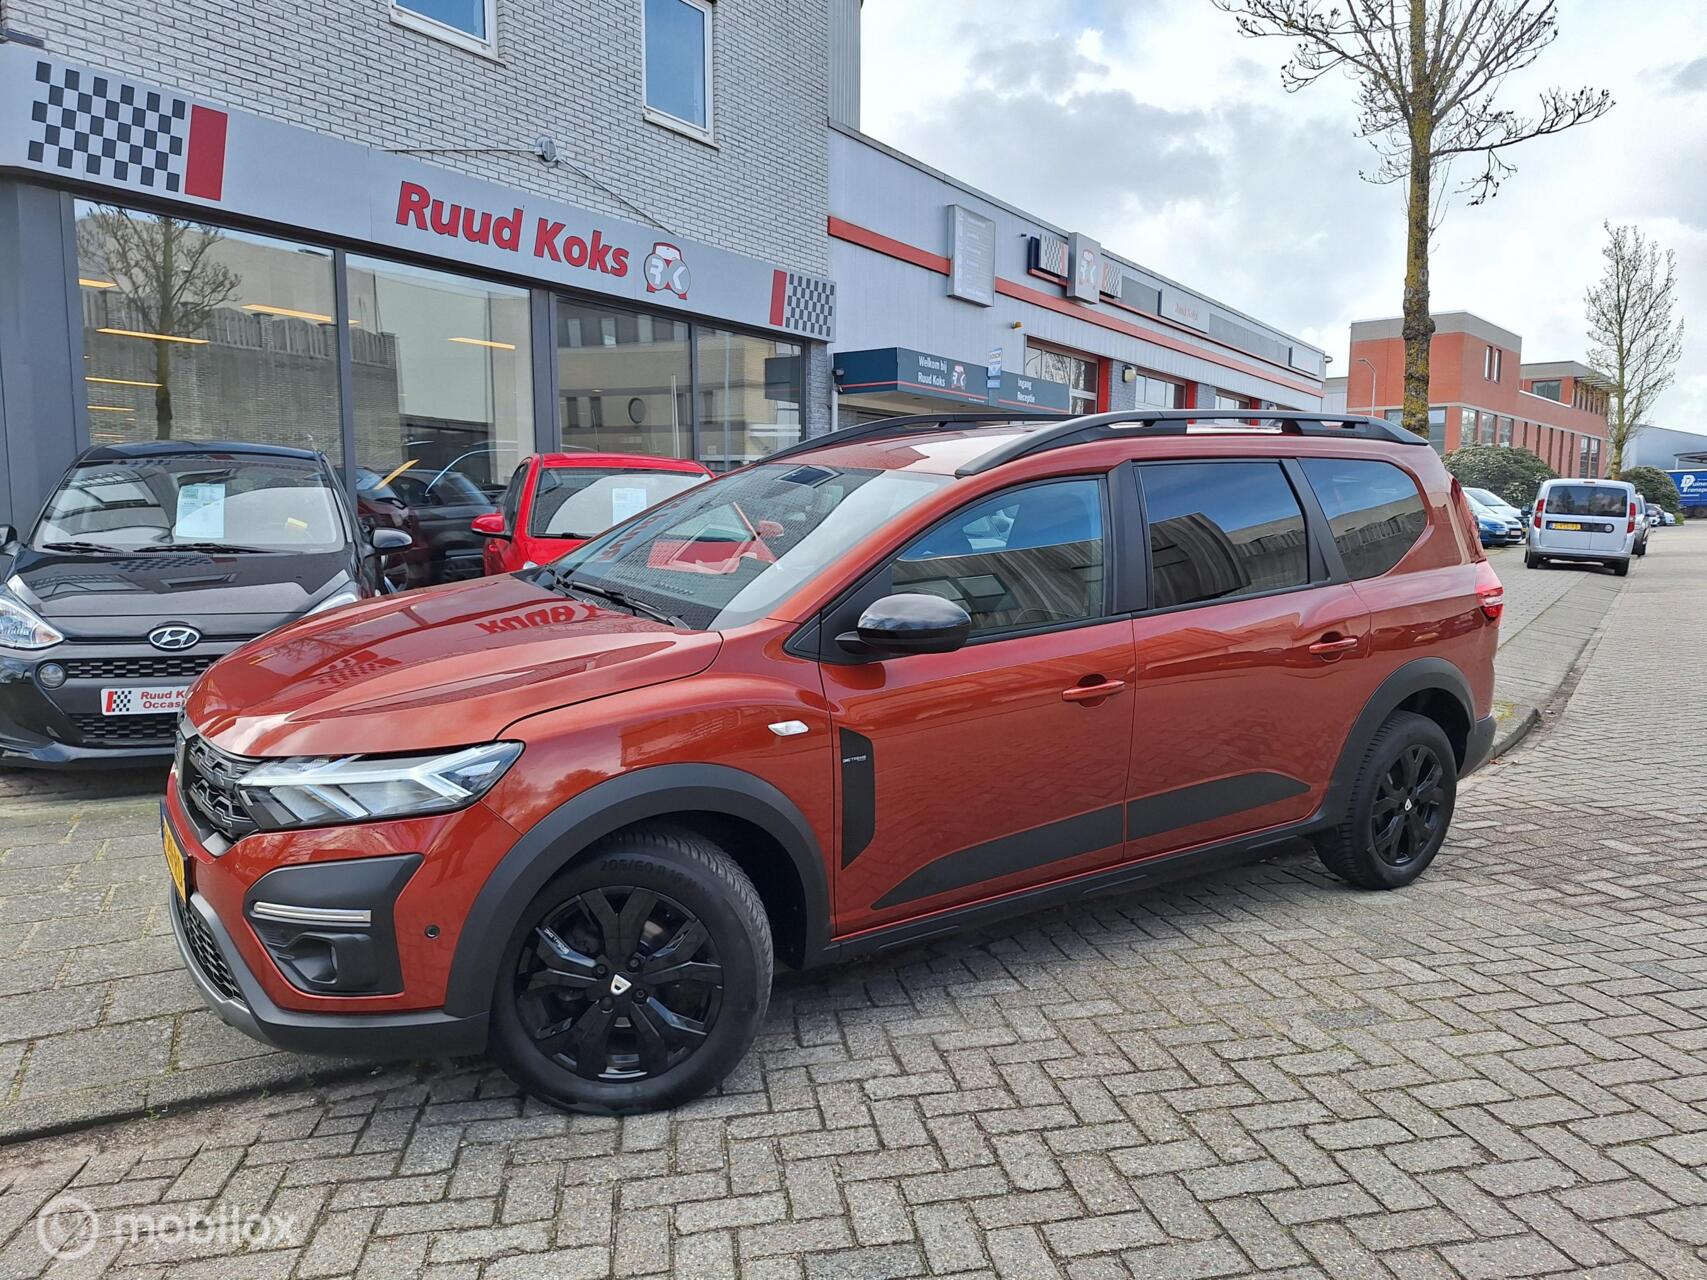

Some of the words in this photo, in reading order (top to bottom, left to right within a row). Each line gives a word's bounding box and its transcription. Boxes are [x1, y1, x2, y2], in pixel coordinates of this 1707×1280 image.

[396, 180, 524, 252] Ruud
[533, 217, 629, 277] Koks
[918, 355, 940, 370] Welkom
[917, 371, 932, 385] Ruud
[932, 374, 946, 387] Koks
[140, 690, 173, 700] Ruud
